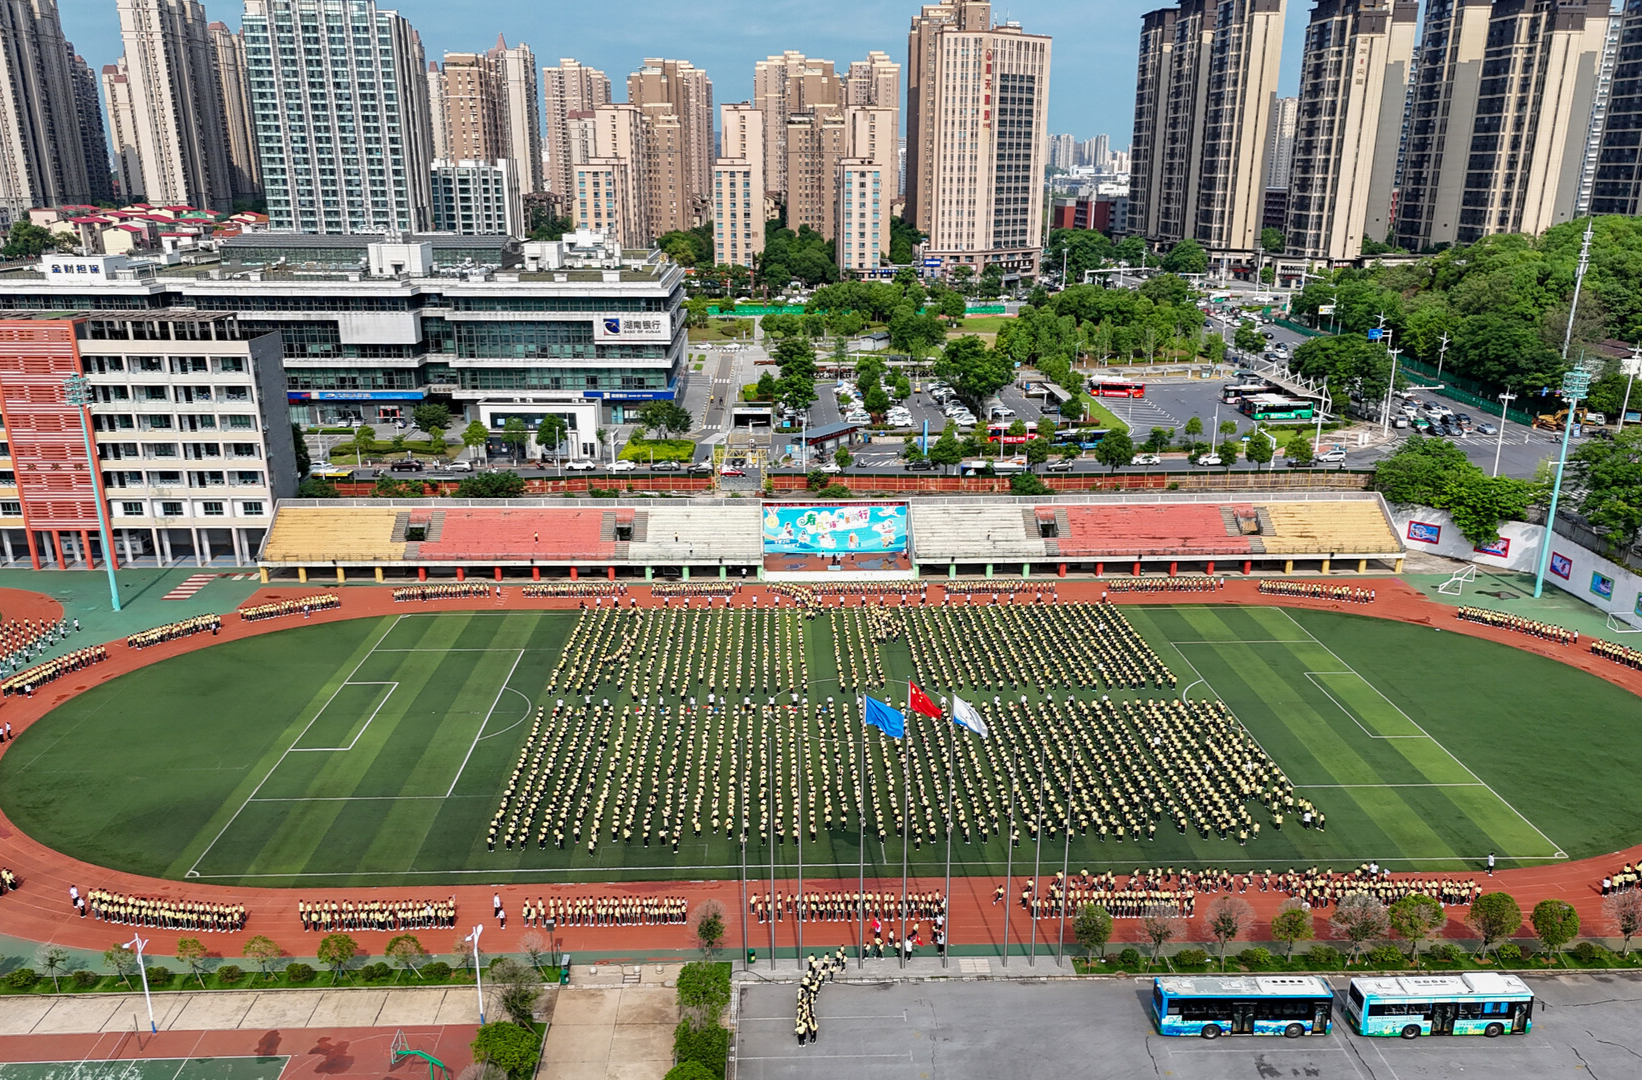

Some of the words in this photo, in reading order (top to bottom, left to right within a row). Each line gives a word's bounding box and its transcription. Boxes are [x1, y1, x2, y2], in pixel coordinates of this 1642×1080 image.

[51, 264, 100, 274] 金财担保
[623, 320, 661, 330] 湖南银行
